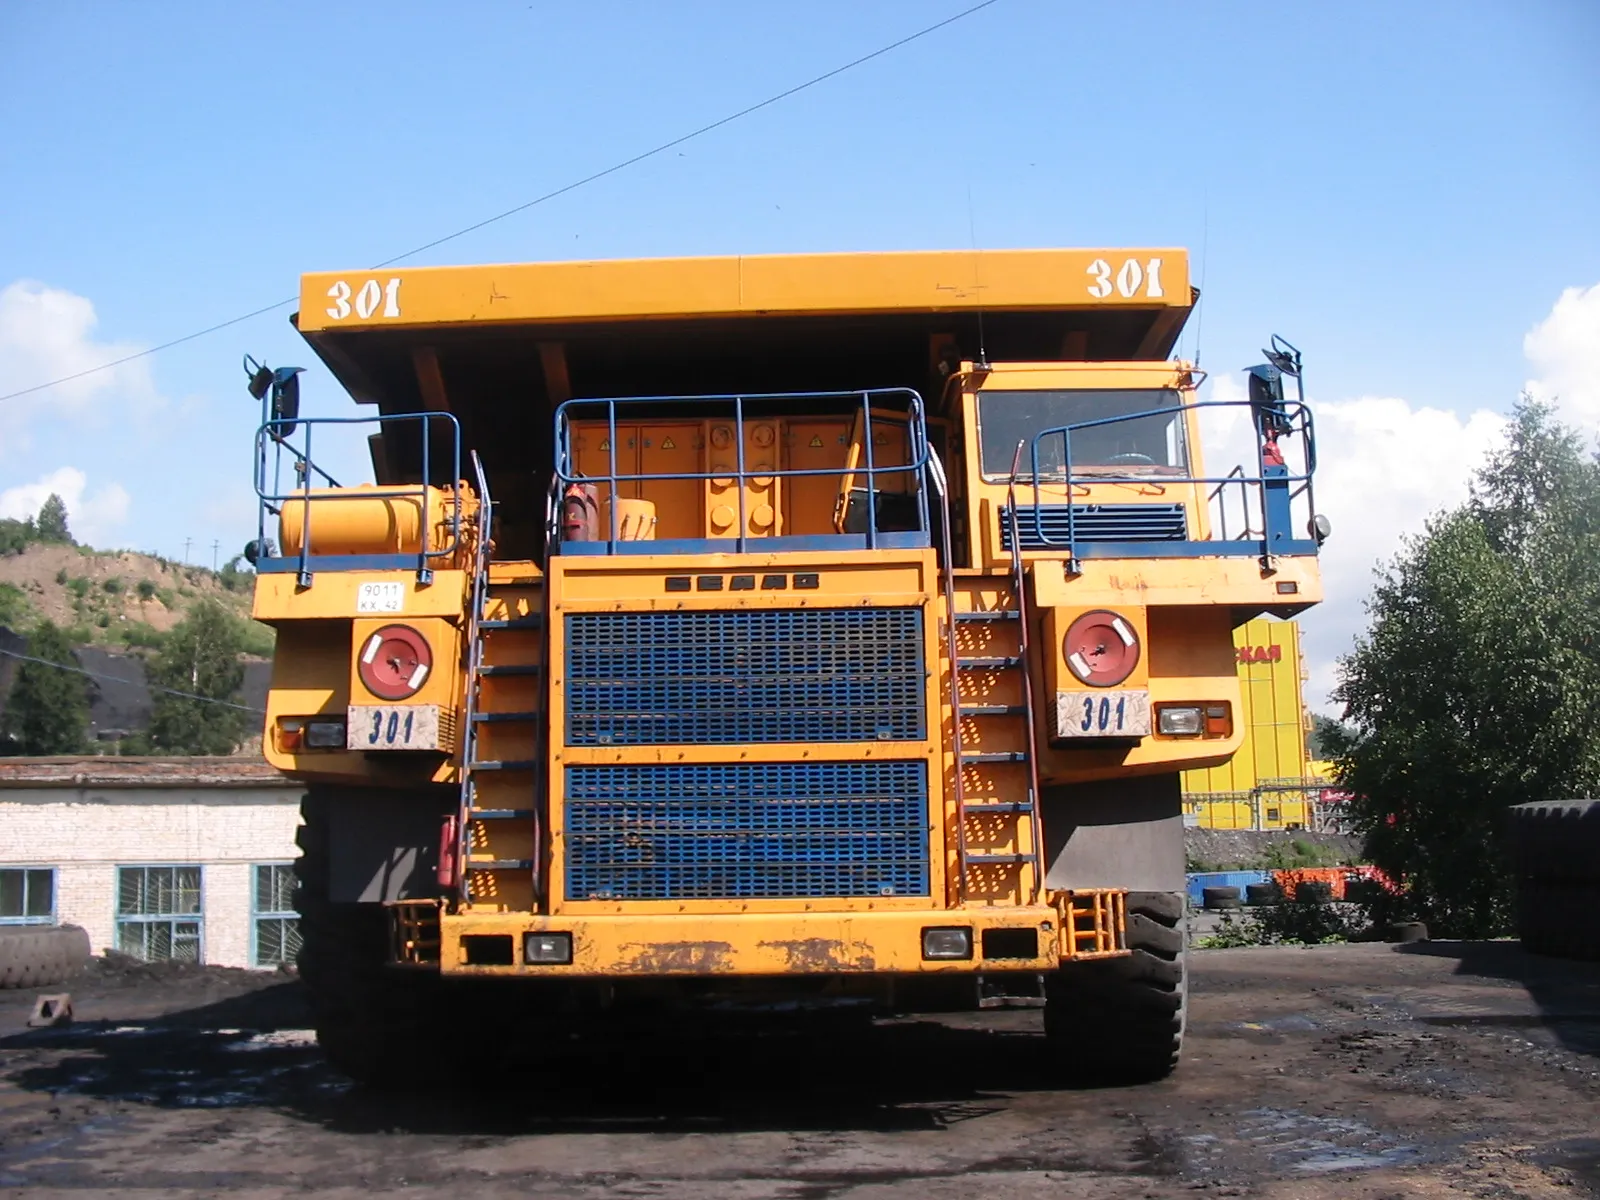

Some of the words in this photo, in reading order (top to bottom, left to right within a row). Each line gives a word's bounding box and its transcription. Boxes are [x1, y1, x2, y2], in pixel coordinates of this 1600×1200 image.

[1086, 258, 1163, 298] 301
[325, 277, 401, 319] 301
[364, 584, 398, 596] 9011
[385, 600, 398, 610] 42
[369, 711, 414, 744] 301
[1081, 697, 1125, 731] 301
